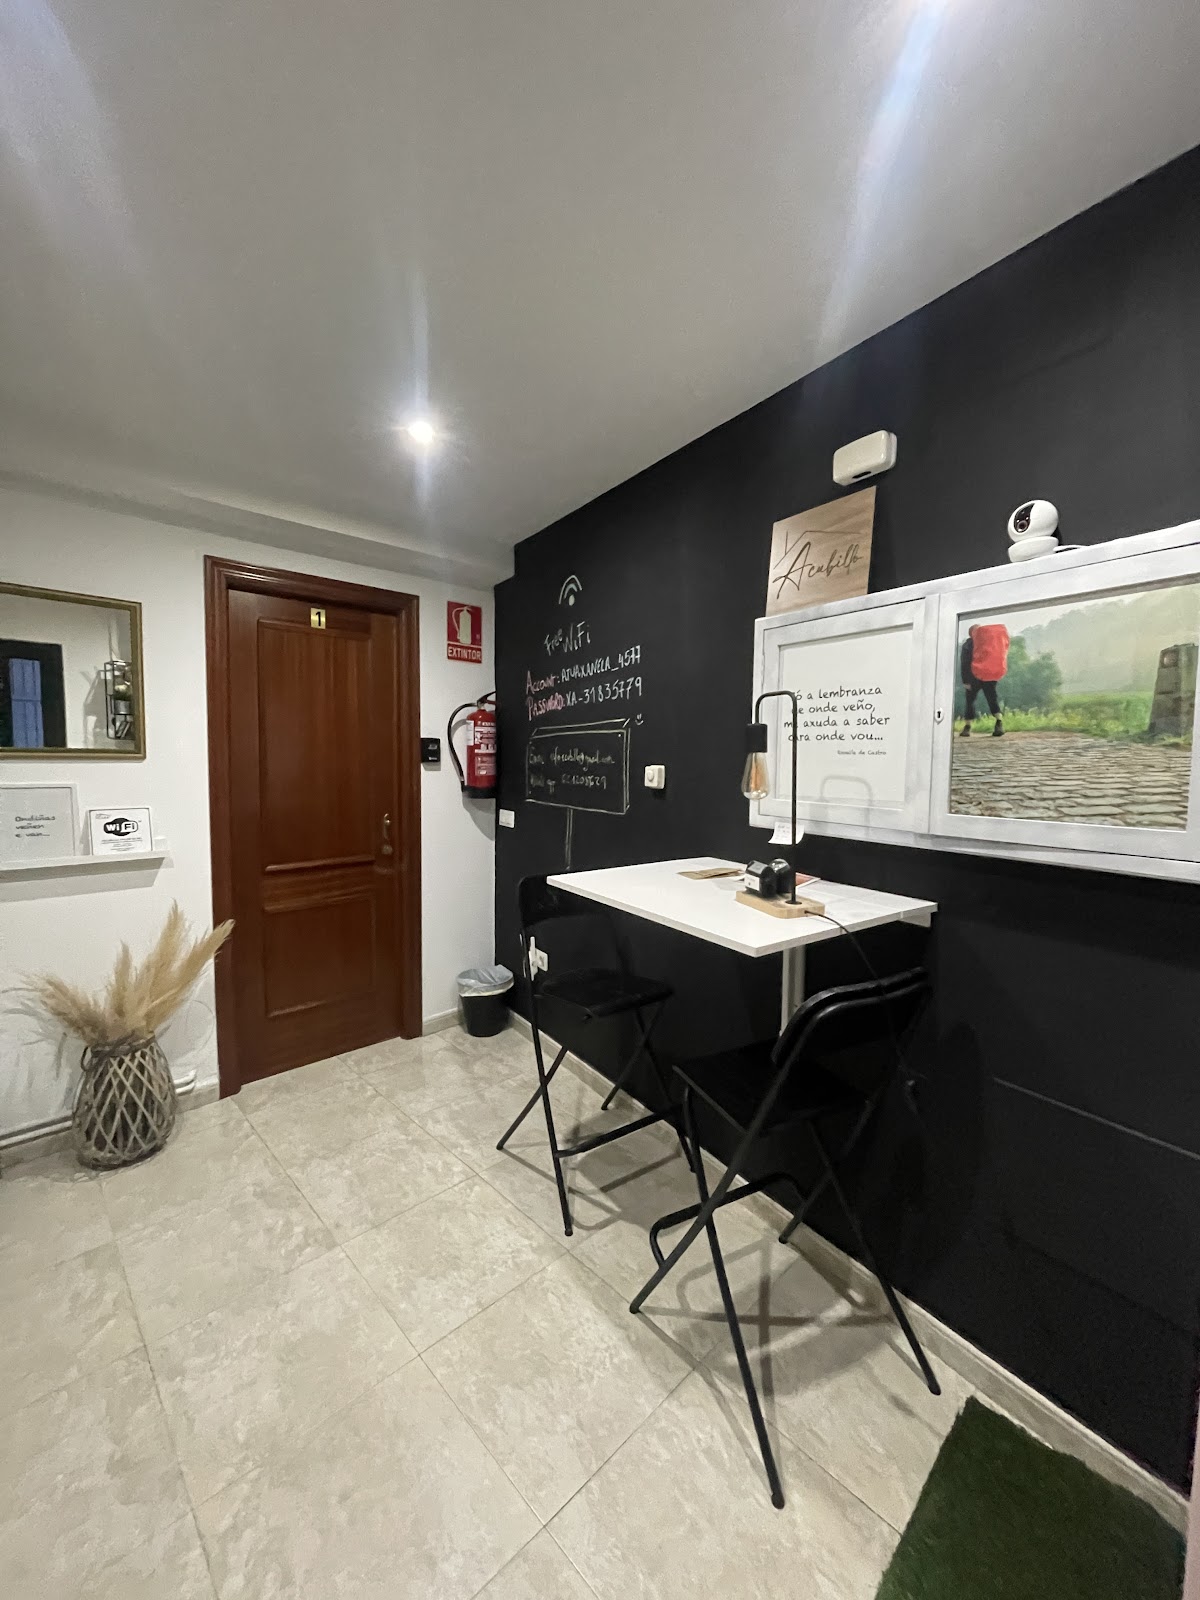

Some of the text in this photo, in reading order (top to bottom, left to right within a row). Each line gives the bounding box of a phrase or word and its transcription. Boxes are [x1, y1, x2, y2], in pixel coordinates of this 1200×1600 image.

[772, 541, 864, 600] Acubillo
[316, 611, 321, 627] 1
[448, 646, 482, 661] EXTINTOR
[818, 686, 882, 699] lembranza
[808, 702, 838, 713] onde
[843, 699, 876, 712] veño,
[803, 716, 838, 728] axuda
[856, 713, 890, 726] saber
[815, 730, 846, 741] onde
[850, 733, 883, 741] vou...
